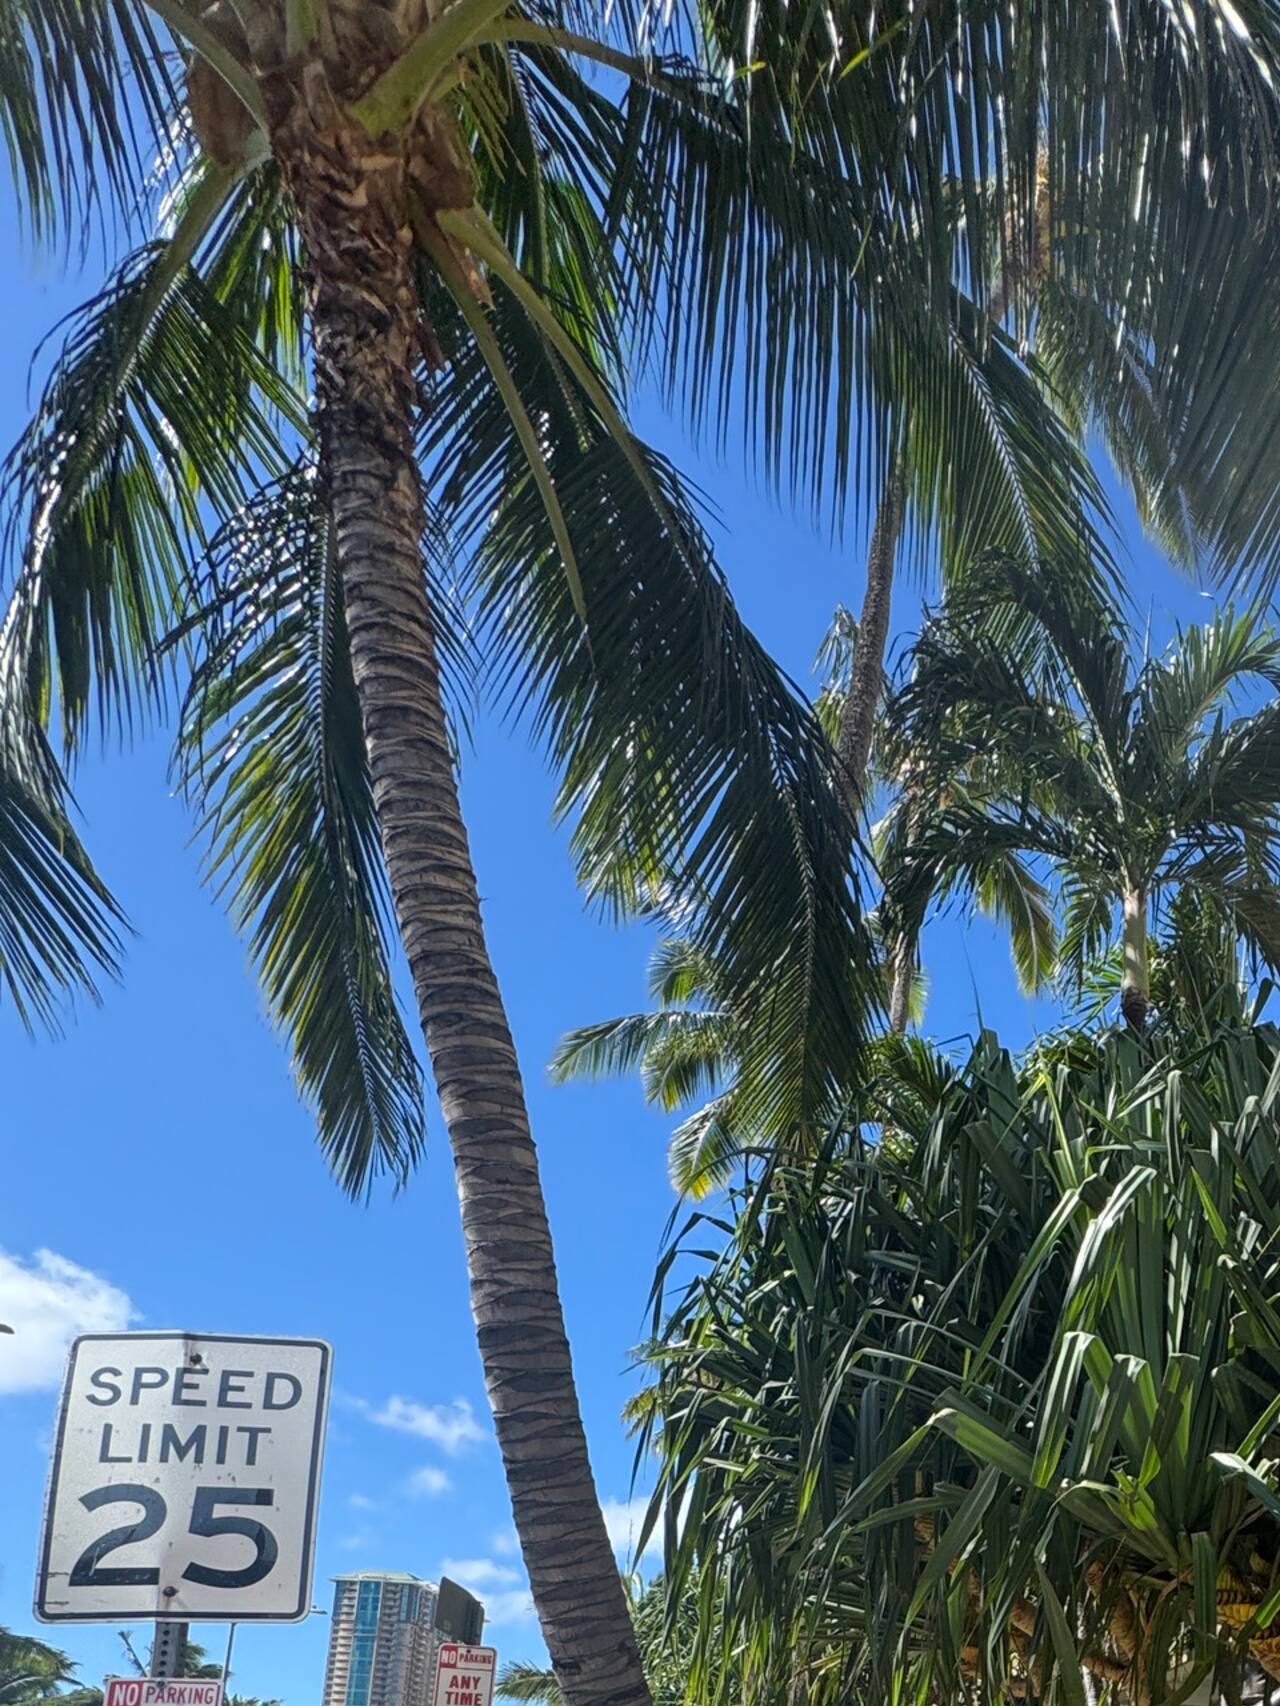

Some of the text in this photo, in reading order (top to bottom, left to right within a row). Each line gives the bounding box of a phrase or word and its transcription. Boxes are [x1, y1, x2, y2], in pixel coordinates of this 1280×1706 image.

[86, 1366, 303, 1411] SPEED
[98, 1423, 272, 1466] LIMIT
[68, 1483, 279, 1589] 25
[440, 1650, 493, 1665] NO PARKING
[448, 1675, 482, 1690] ANY
[112, 1683, 215, 1706] NO PARKING
[444, 1691, 483, 1706] TIME
